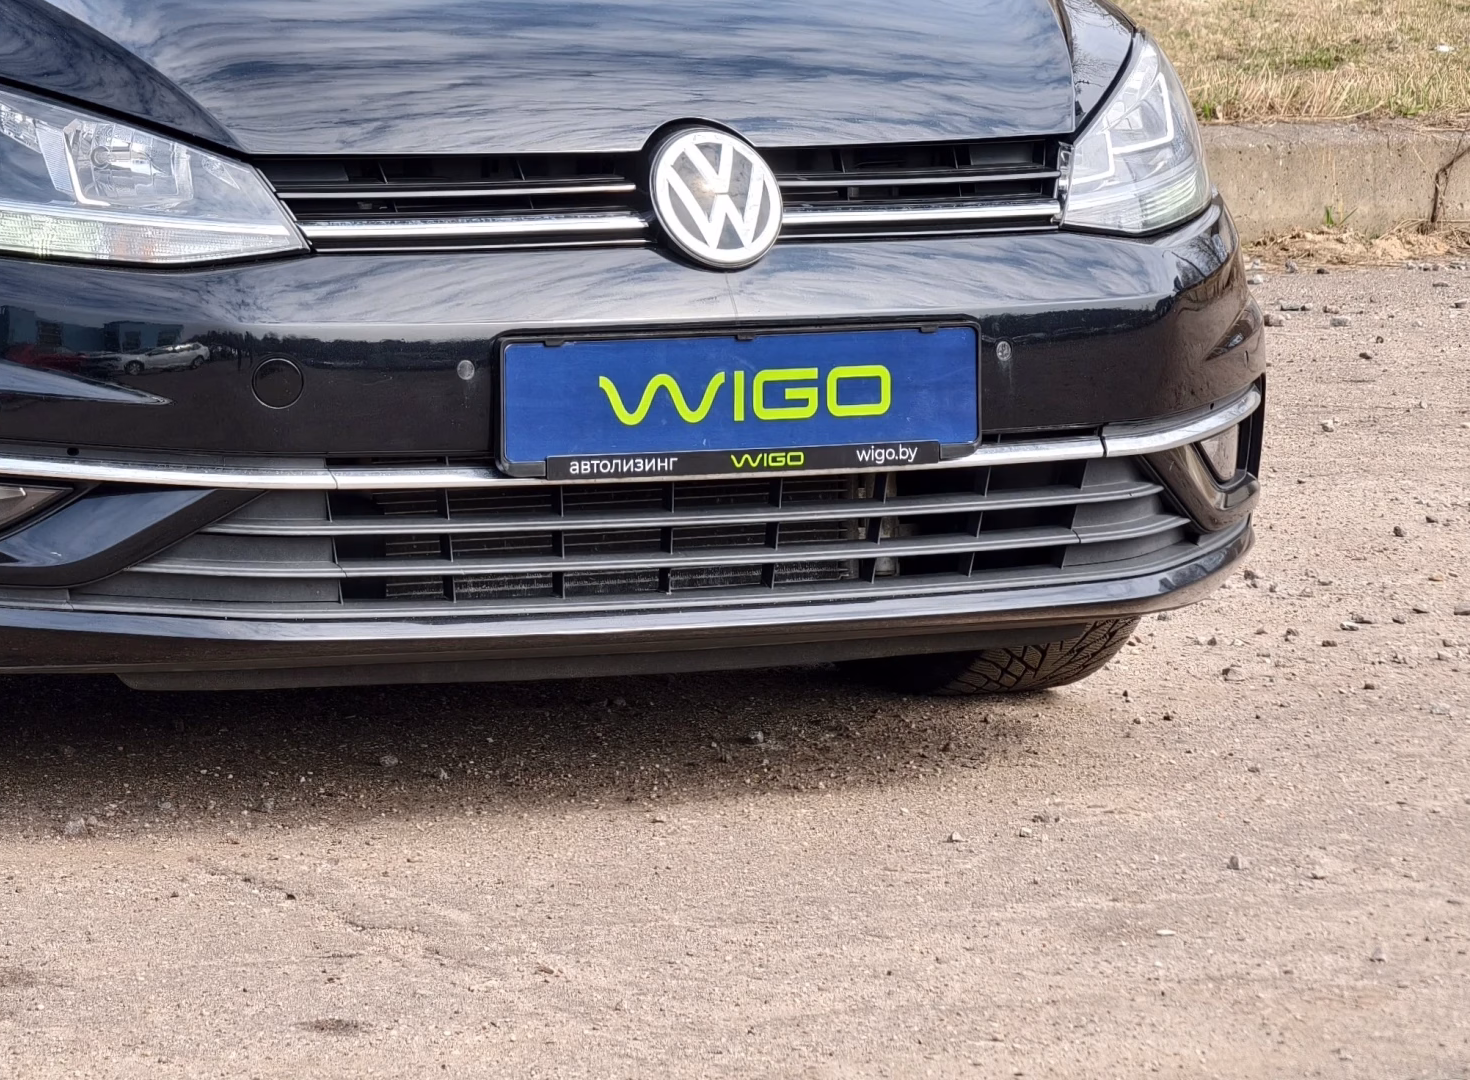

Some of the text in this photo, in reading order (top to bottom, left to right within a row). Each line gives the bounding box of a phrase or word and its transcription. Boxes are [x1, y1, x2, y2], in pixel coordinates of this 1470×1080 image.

[598, 364, 892, 426] WIGO
[569, 445, 918, 475] автолизинг WIGO wigo.by
